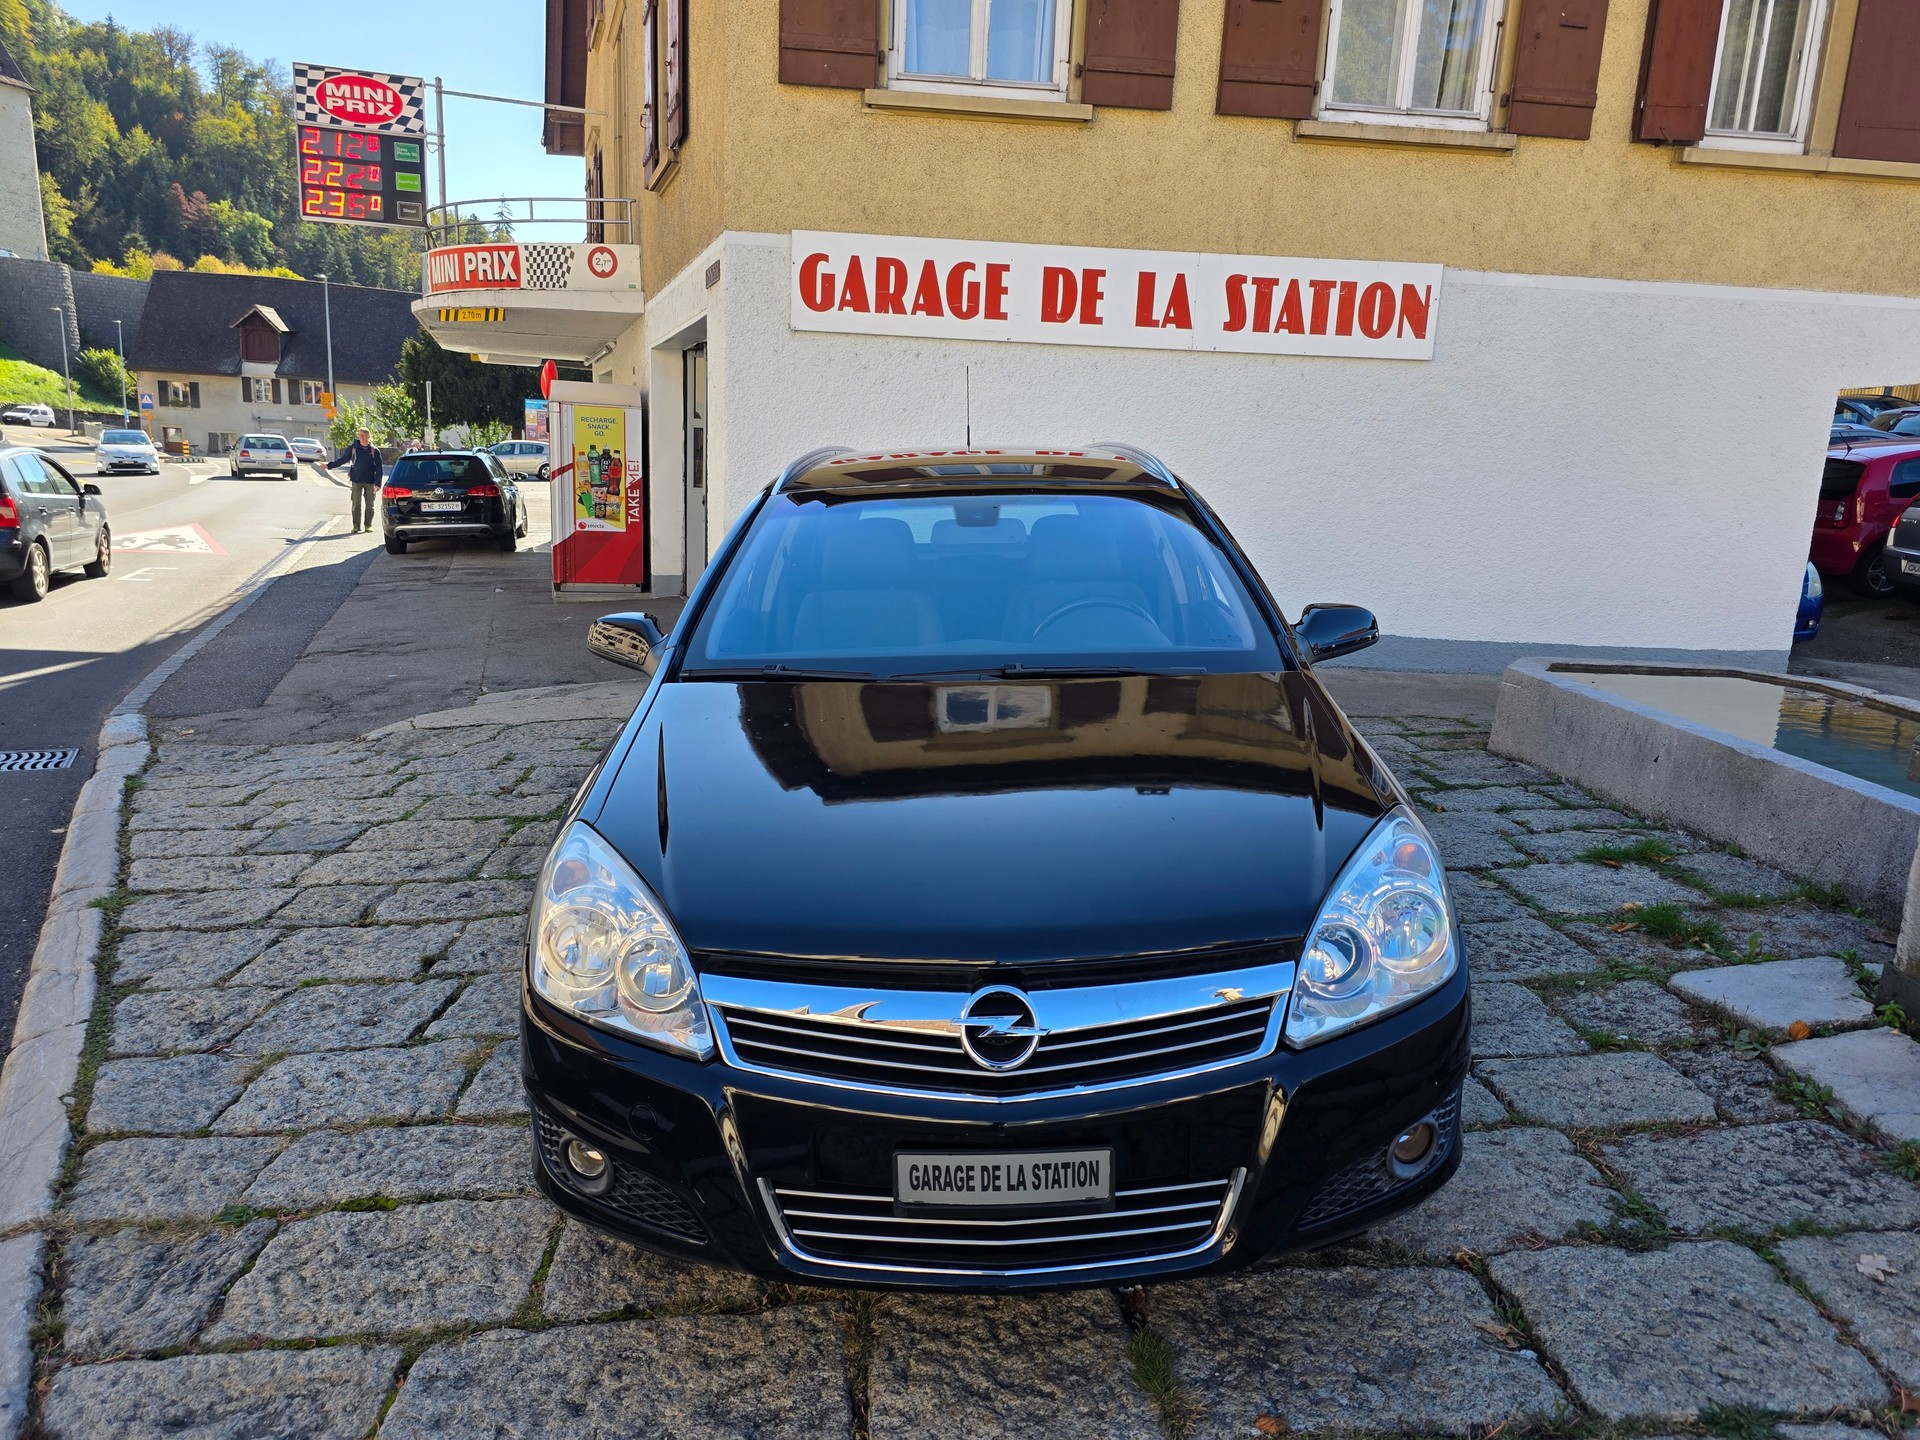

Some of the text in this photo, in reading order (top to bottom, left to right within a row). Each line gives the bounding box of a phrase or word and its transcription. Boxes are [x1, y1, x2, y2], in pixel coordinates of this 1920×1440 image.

[325, 82, 393, 103] MINI
[325, 97, 396, 118] PRIX
[431, 250, 518, 285] MINI PRIX
[799, 252, 1432, 340] GARAGE DE LA STATION
[580, 416, 618, 425] RECHARGE.
[587, 423, 612, 431] SNACK.
[628, 460, 640, 525] TAKE ME!
[909, 1159, 1100, 1192] GARAGE DE LA STATION
